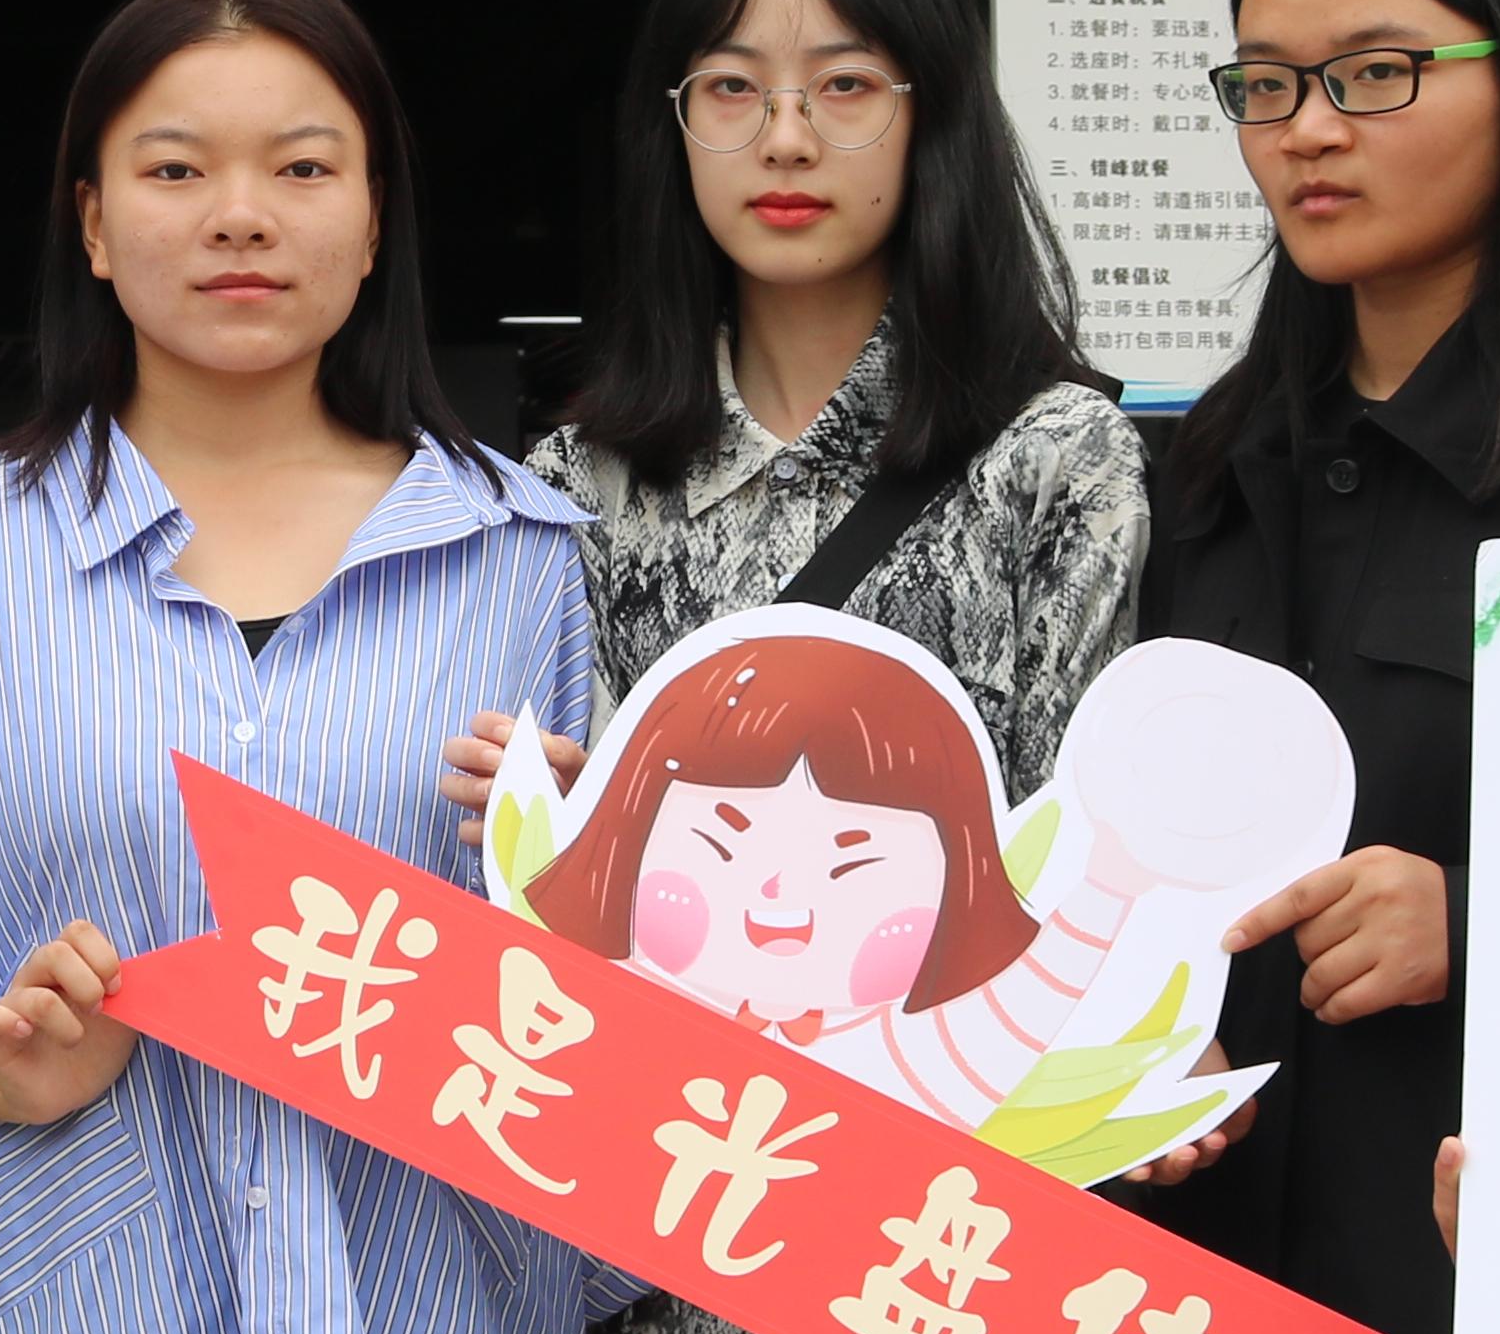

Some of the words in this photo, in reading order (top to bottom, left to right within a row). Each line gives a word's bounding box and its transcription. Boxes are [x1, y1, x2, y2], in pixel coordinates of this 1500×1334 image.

[1050, 159, 1169, 177] 三、错峰就餐
